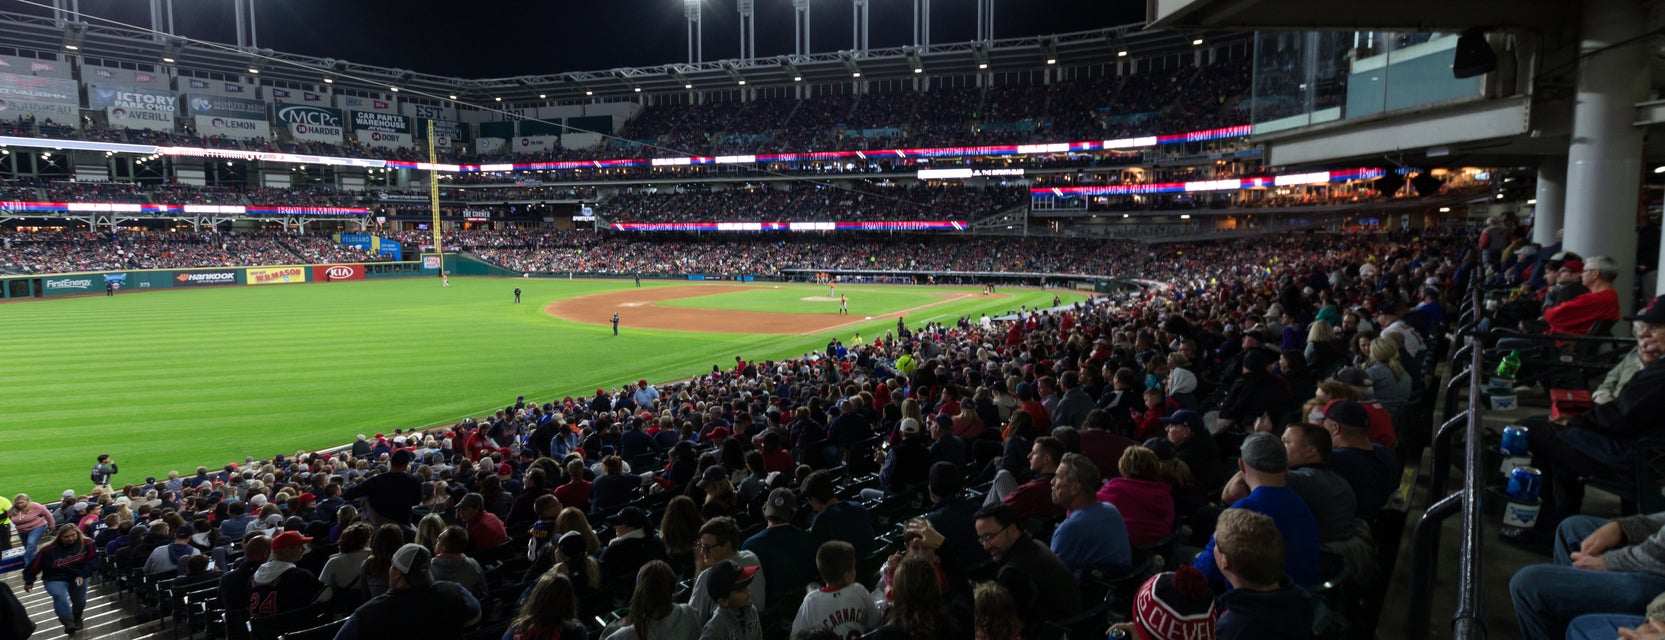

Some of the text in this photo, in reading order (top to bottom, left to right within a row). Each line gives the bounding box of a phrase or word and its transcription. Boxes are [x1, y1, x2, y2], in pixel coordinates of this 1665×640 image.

[114, 100, 175, 112] PARK OHIO
[128, 110, 170, 122] AVERILL
[357, 111, 404, 122] CAR PARTS
[415, 105, 447, 120] EST.
[502, 109, 526, 121] 1901
[225, 120, 256, 130] LEMON
[355, 117, 406, 129] WAREHOUSE
[308, 126, 340, 136] HARDER
[381, 134, 400, 142] DOBY
[463, 209, 491, 218] THE CORNER
[330, 268, 349, 276] KIA
[46, 278, 92, 289] FirstEnergy
[248, 591, 278, 617] 24
